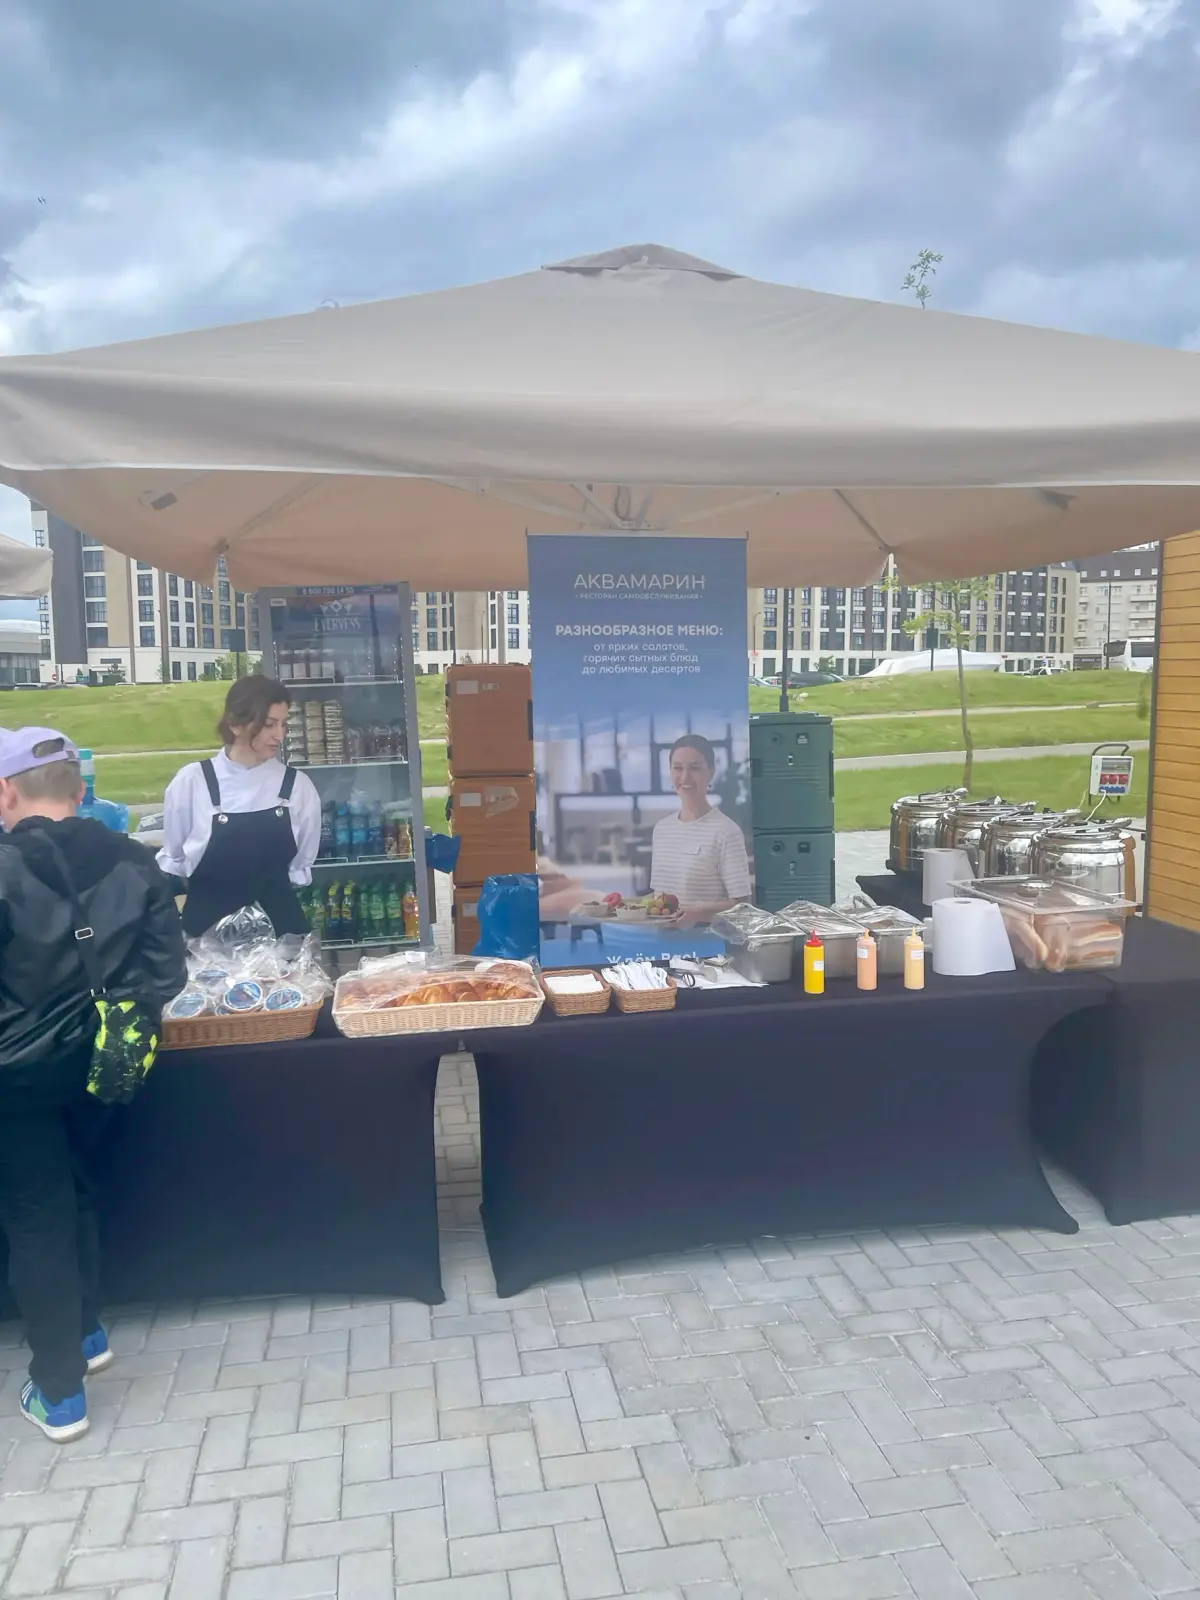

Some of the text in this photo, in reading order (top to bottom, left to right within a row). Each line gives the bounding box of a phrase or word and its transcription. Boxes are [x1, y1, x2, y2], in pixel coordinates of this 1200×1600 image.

[573, 573, 705, 590] АКВАМАРИН
[580, 592, 699, 600] РЕСТОРАН САМООБСЛУЖИВАНИЯ
[313, 617, 362, 632] EVERVESS
[555, 624, 724, 636] РАЗНООБРАЗНОЕ МЕНЮ:
[593, 643, 688, 653] от ярких салатов,
[583, 653, 699, 665] горячих сытных блюд
[581, 664, 701, 676] до любимых десертов
